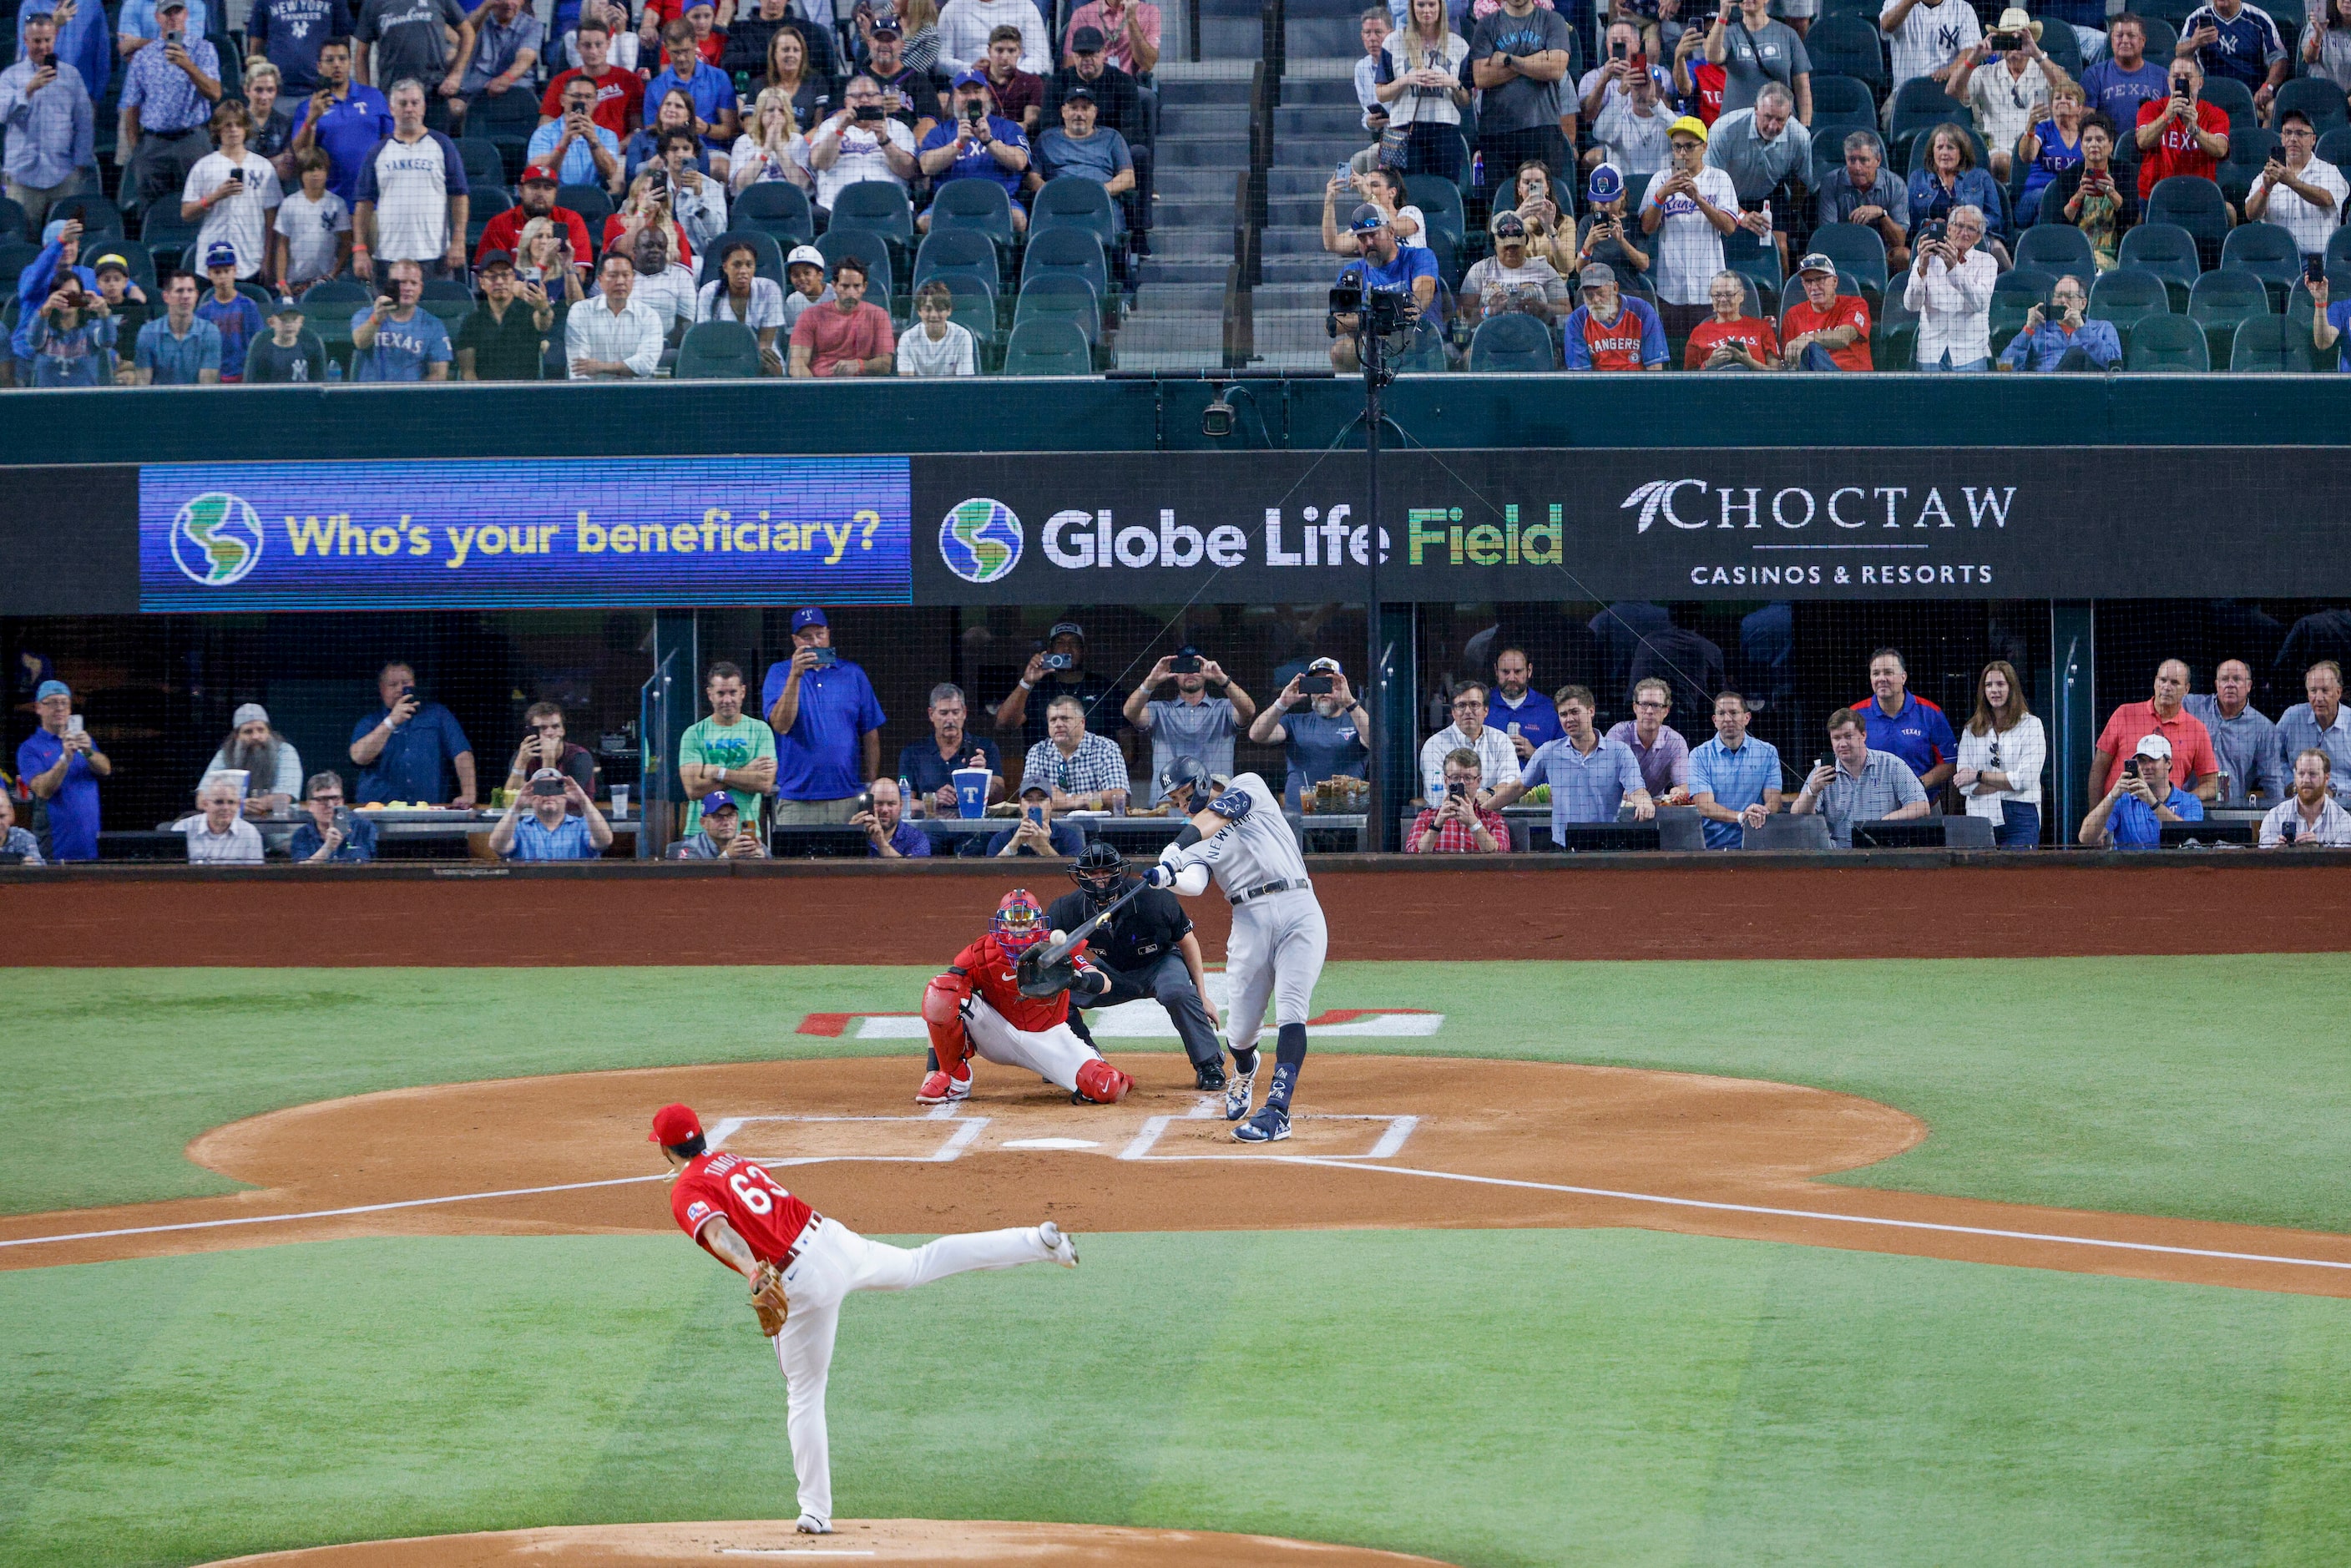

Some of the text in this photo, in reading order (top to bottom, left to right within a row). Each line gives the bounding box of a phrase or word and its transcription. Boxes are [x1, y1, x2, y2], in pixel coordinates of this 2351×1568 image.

[269, 0, 332, 17] NEW YORK
[1495, 28, 1543, 50] NEW YORK
[2218, 33, 2238, 55] NY
[2104, 83, 2161, 101] TEXAS
[384, 158, 435, 174] YANKEES
[374, 331, 424, 355] TEXAS
[1588, 337, 1641, 354] RANGERS
[1664, 478, 2017, 530] CHOCTAW
[285, 508, 881, 569] Who's your beneficiary?
[1041, 503, 1565, 569] Globe Life Field
[1690, 564, 1994, 585] CASINOS & RESORTS
[1901, 728, 1922, 736] TEXAS
[1162, 774, 1172, 785] NY
[963, 787, 979, 803] T
[1206, 828, 1230, 860] NEW
[704, 1152, 746, 1177] TINOC
[729, 1165, 791, 1215] 63
